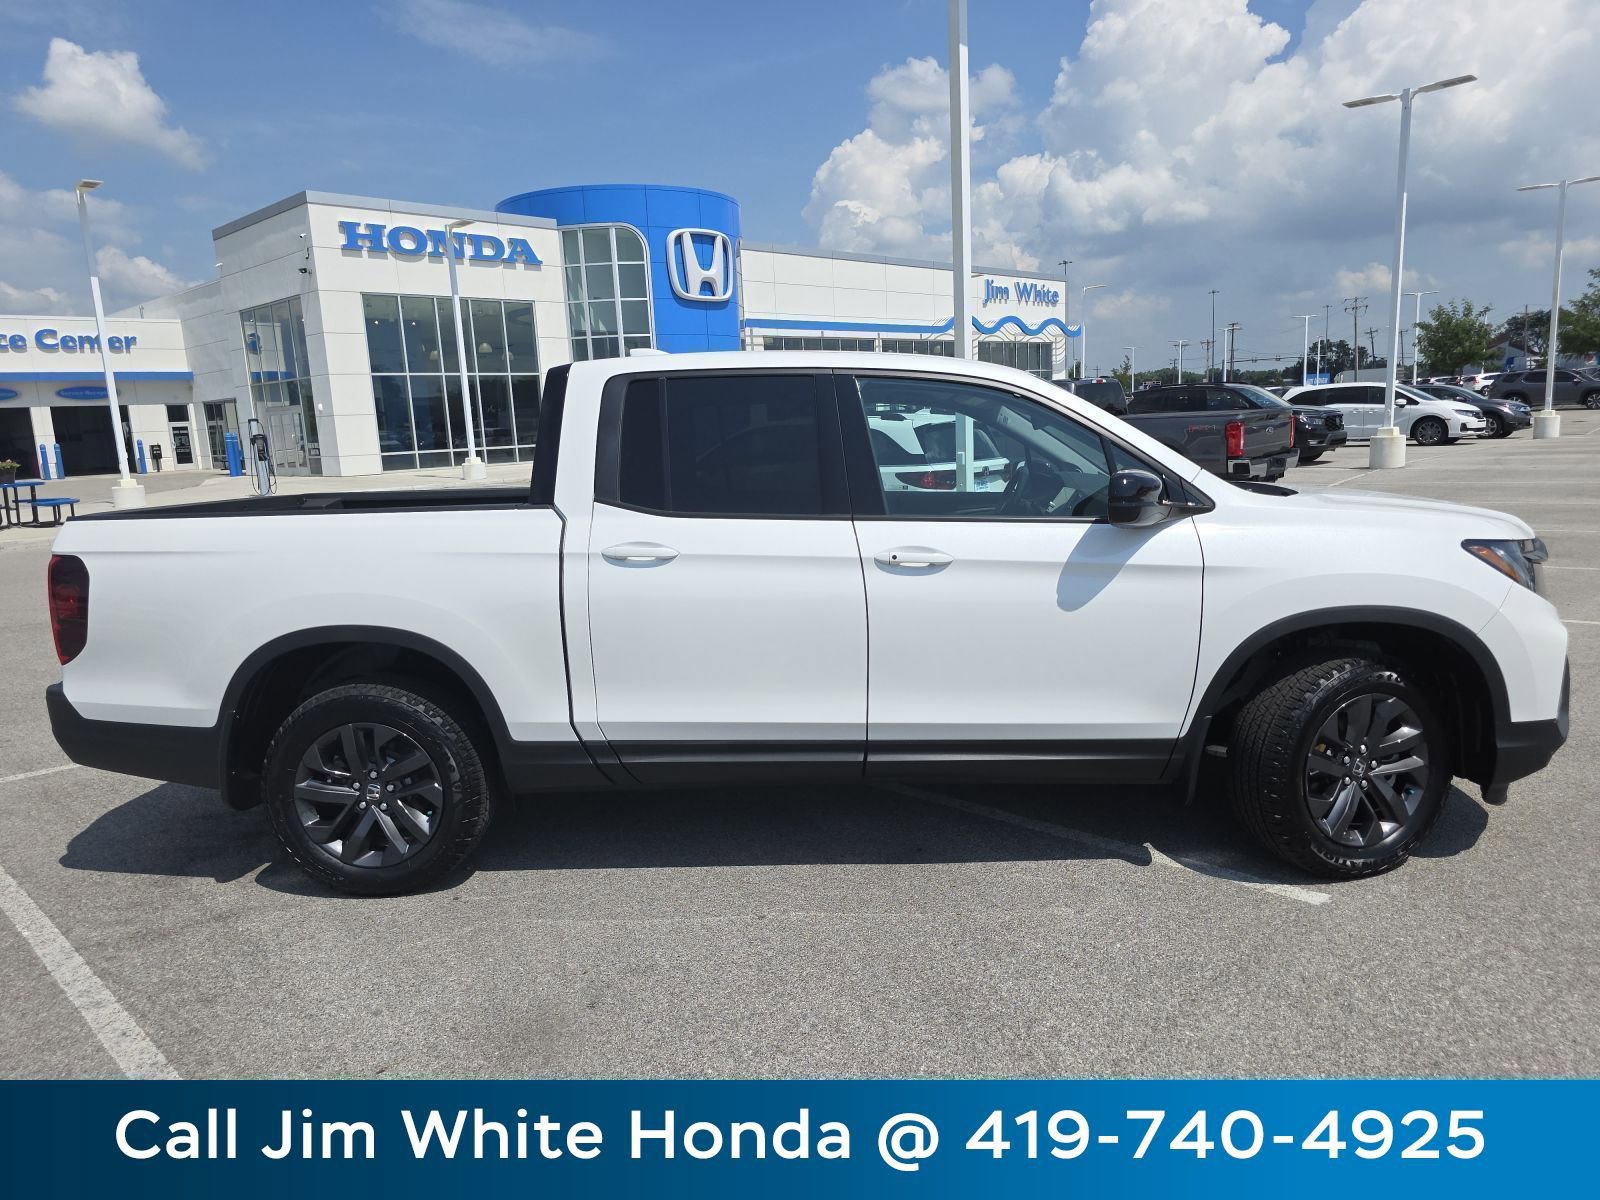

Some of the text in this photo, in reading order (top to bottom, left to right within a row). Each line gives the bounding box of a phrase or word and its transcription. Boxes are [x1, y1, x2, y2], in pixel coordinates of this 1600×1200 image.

[338, 220, 543, 266] HONDA
[983, 278, 1059, 304] Jim White
